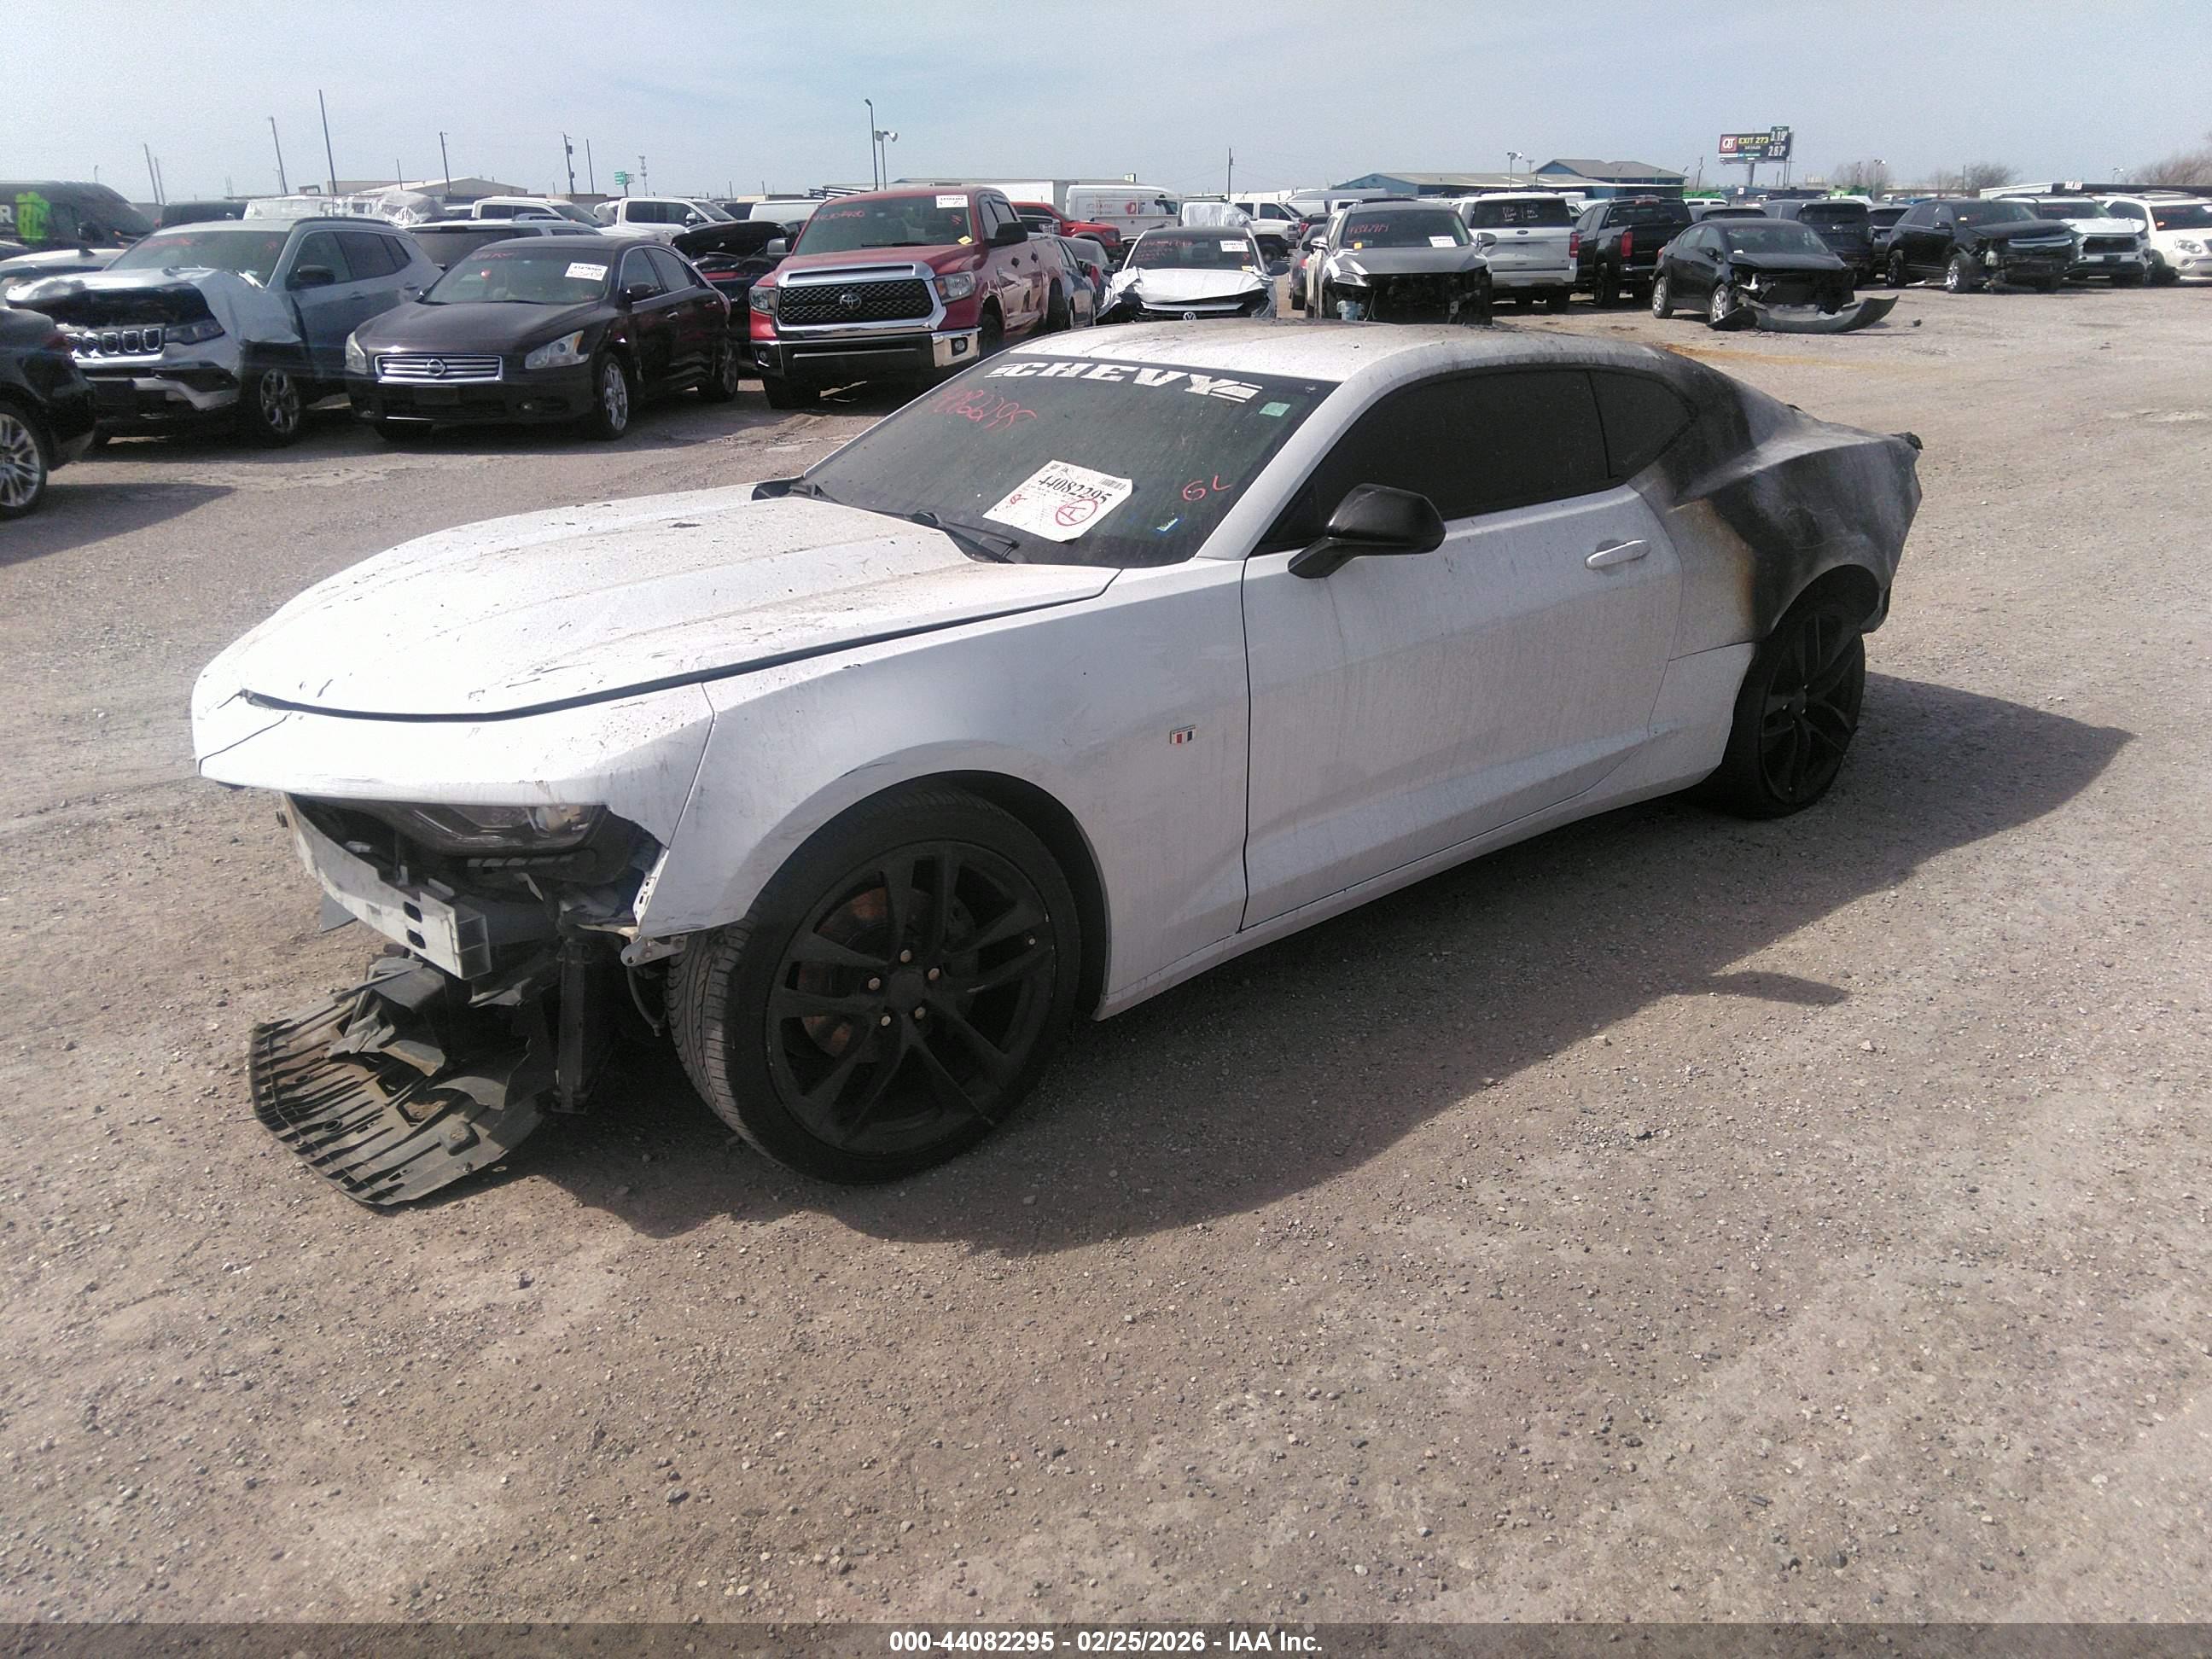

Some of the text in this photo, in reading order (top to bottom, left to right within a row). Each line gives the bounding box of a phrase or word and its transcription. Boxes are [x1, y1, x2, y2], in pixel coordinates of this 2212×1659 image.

[1723, 138, 1735, 149] QT
[985, 363, 1262, 403] CHEVY
[1038, 475, 1113, 504] 44082295
